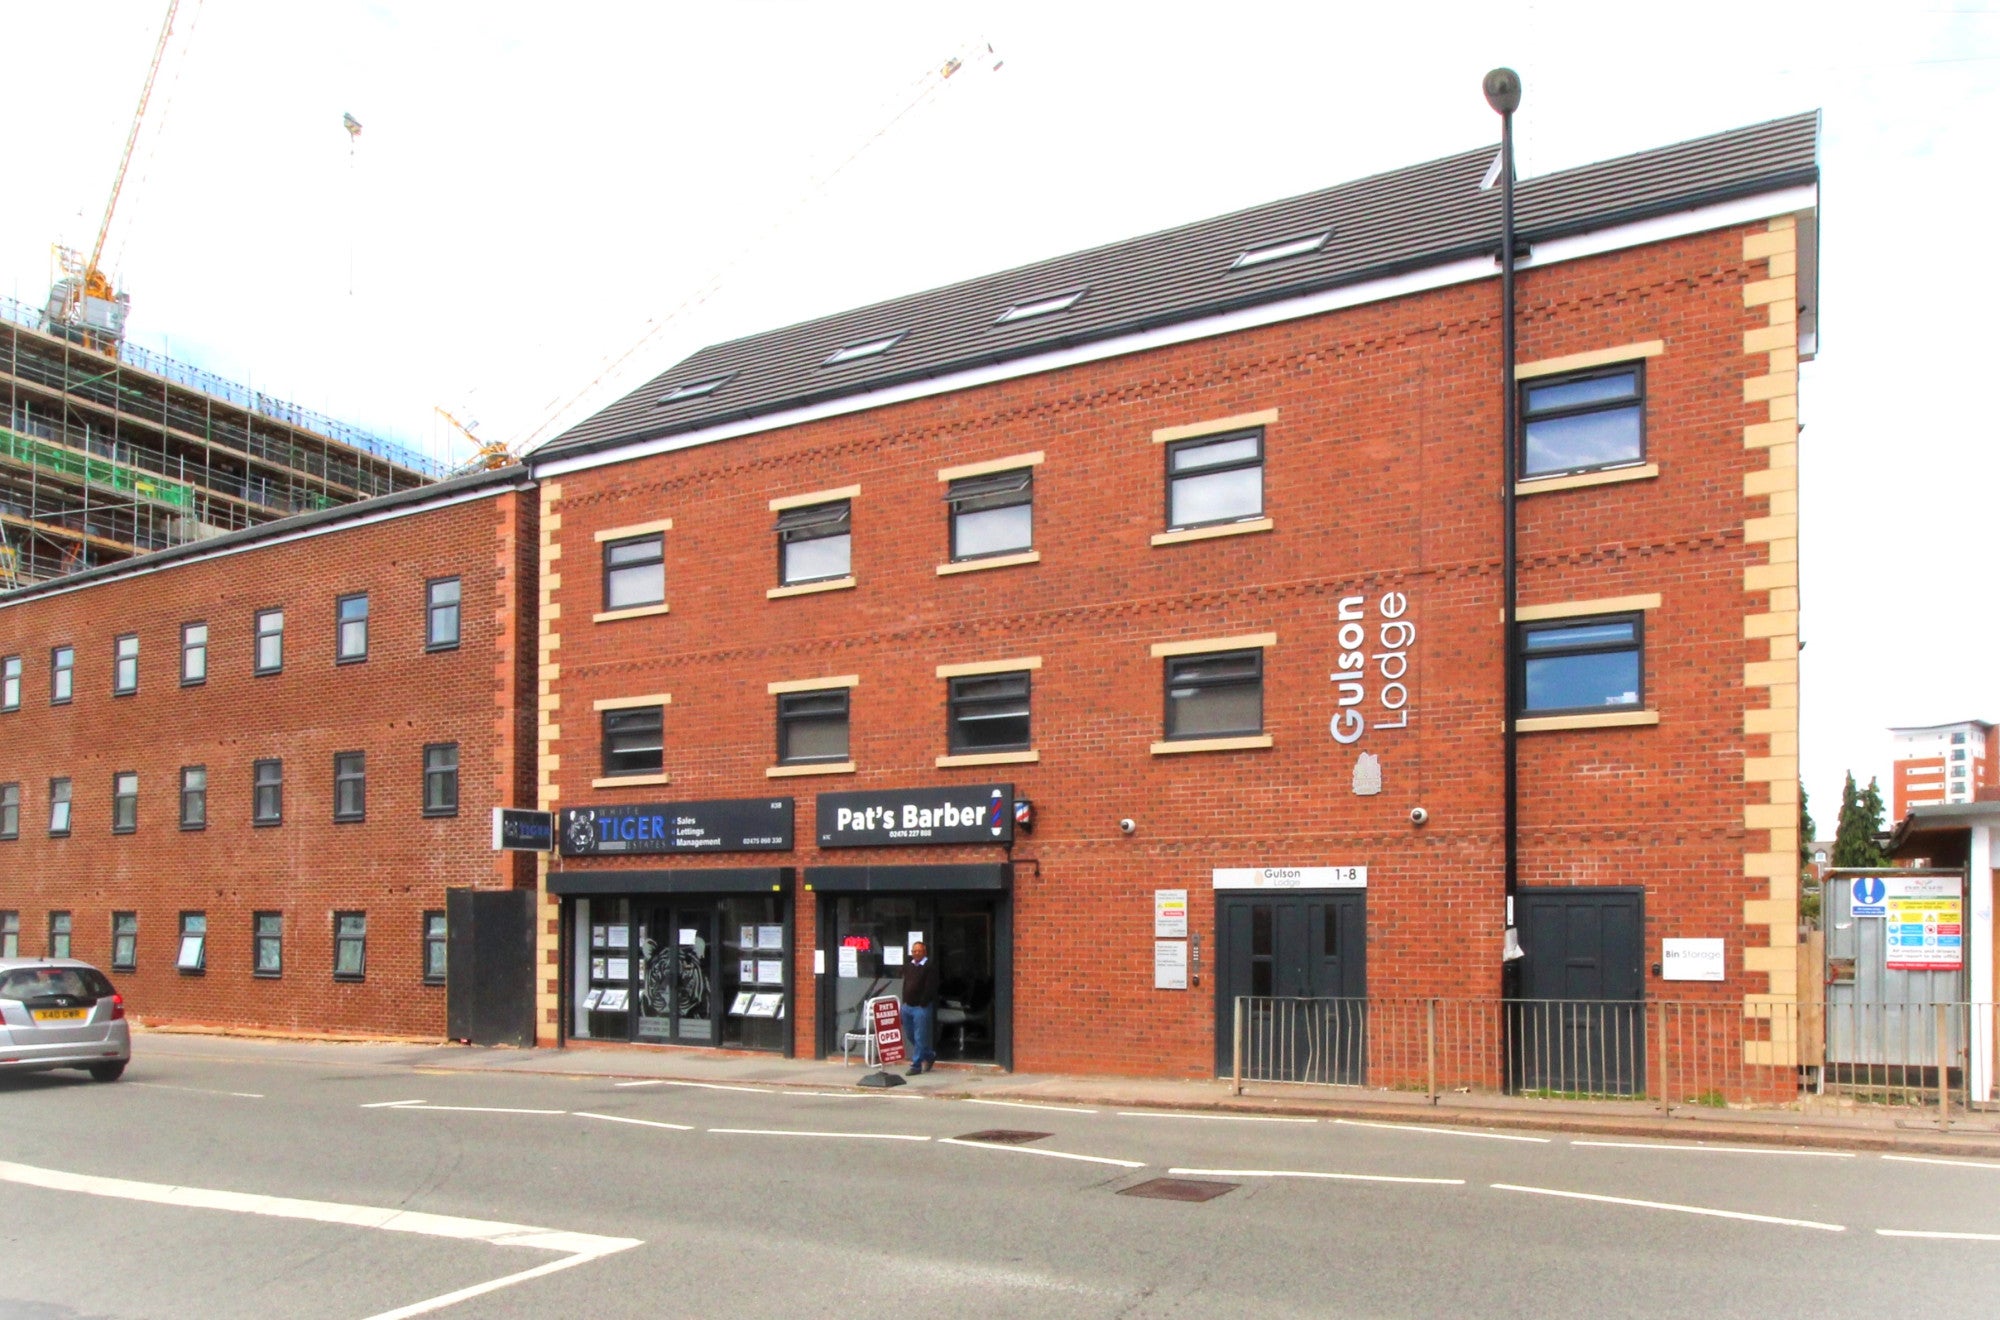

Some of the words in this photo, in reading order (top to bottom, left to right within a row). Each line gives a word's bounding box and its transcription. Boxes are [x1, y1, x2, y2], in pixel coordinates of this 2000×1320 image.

[1372, 591, 1416, 729] Lodge
[1330, 596, 1364, 744] Gulson
[676, 817, 696, 825] Sales
[837, 805, 895, 831] Pat's
[902, 802, 986, 828] Barber
[598, 815, 666, 842] TIGER
[676, 828, 704, 837] Lettings
[676, 838, 721, 848] Management
[1264, 869, 1301, 878] Gulson
[1274, 879, 1300, 888] Lodge
[1665, 950, 1680, 958] Bin
[1682, 950, 1721, 960] Storage
[880, 1031, 899, 1042] OPEN
